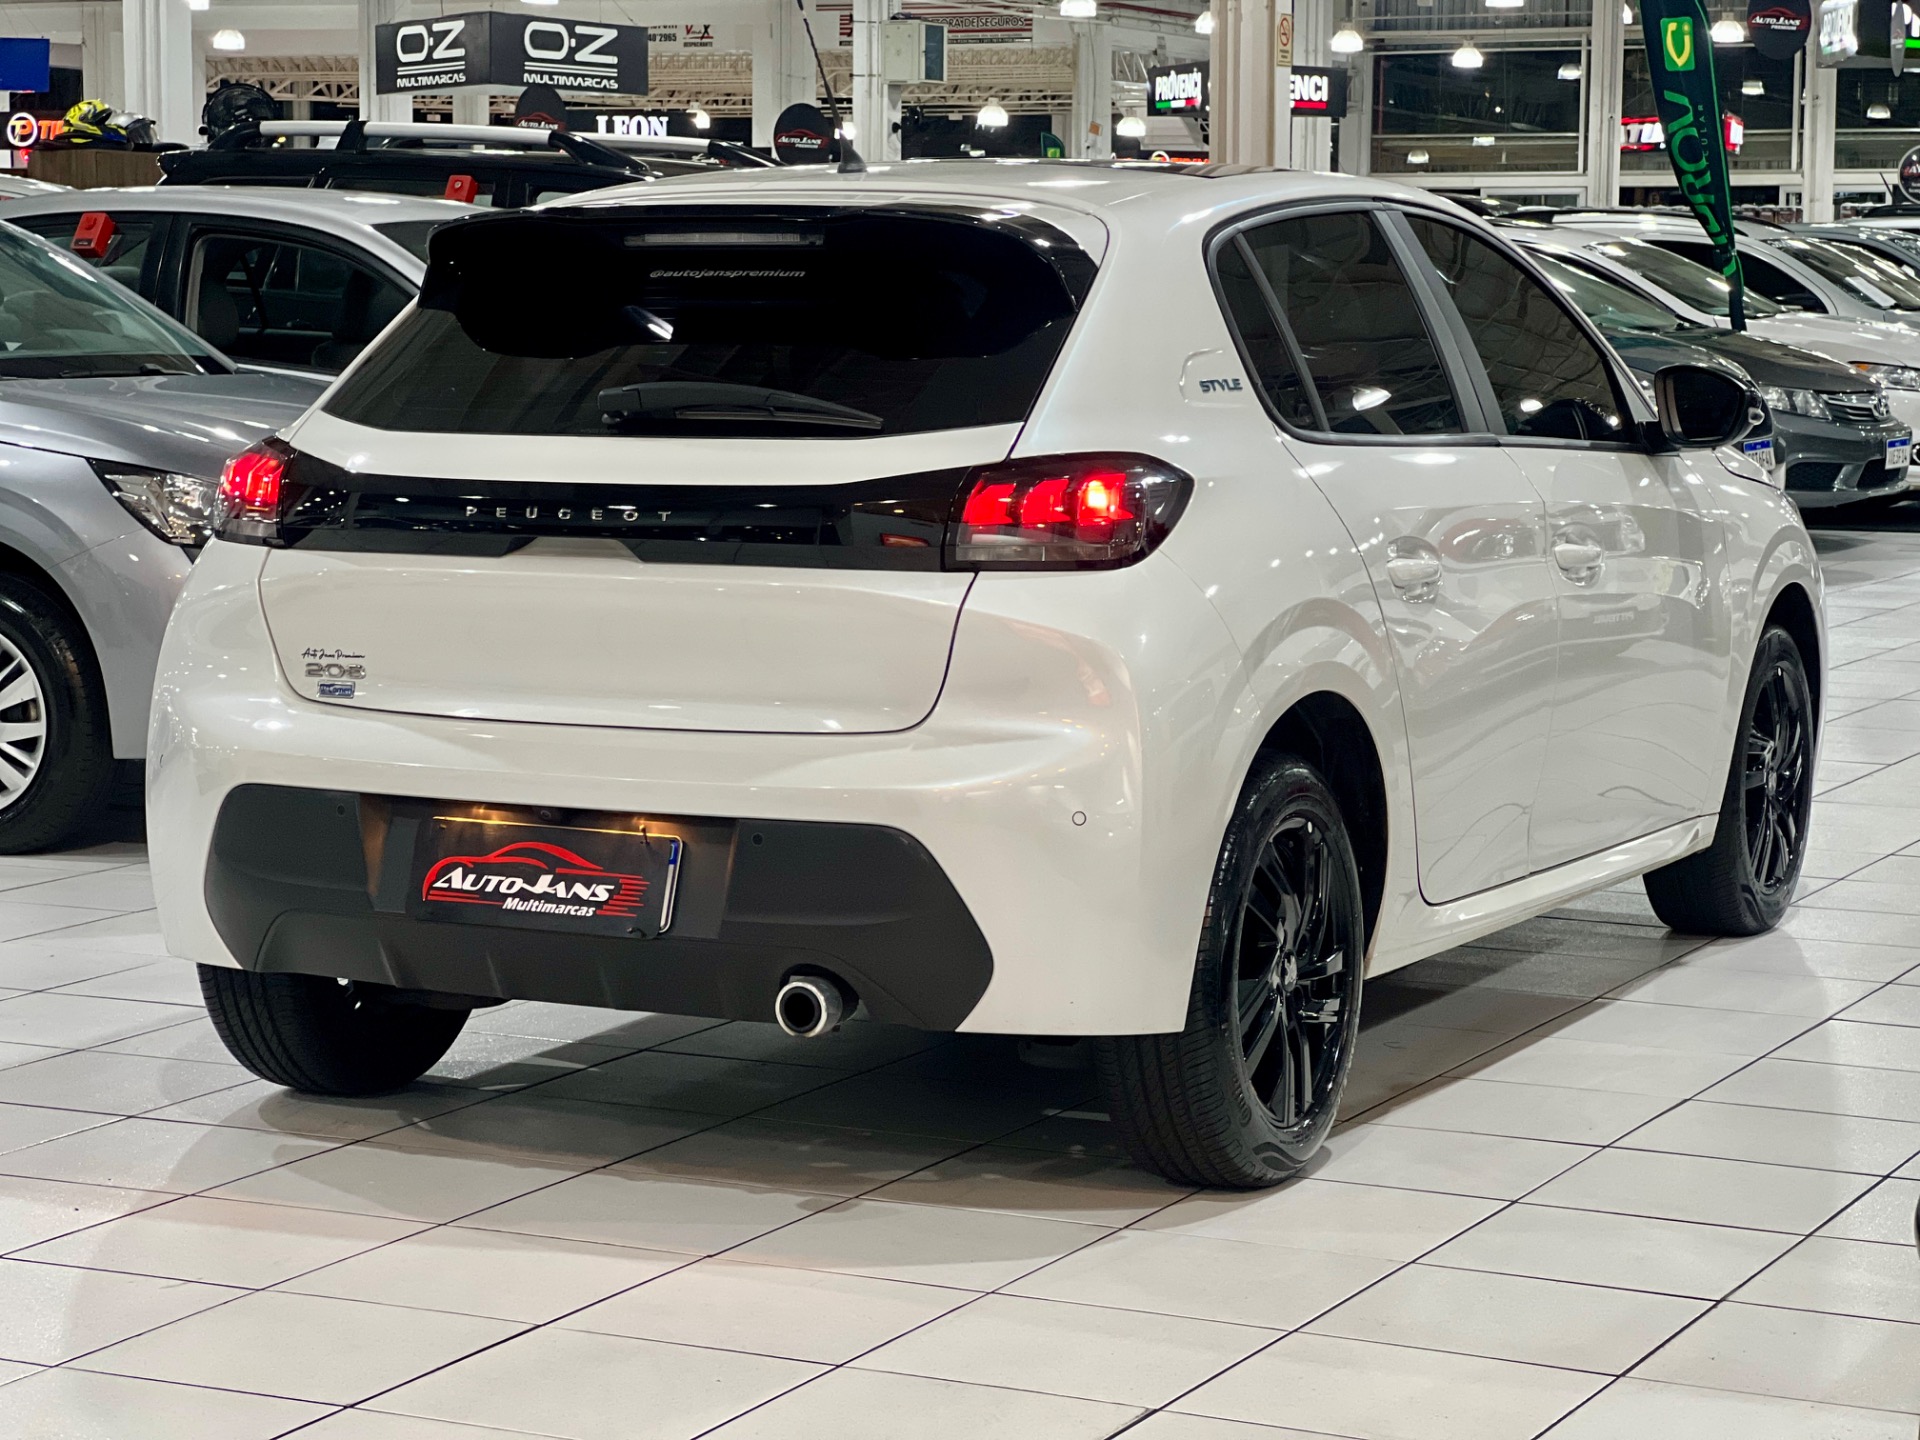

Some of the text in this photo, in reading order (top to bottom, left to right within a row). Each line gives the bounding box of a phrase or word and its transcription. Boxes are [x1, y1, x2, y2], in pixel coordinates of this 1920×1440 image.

[979, 16, 1025, 28] SEGUROS
[396, 73, 467, 88] MULTIMARCAS
[523, 73, 619, 89] MULTIMARCAS
[596, 114, 669, 138] LEON
[650, 268, 806, 279] @autojanspremium
[1199, 378, 1243, 393] STYLE
[465, 505, 672, 523] PEUGEOT
[305, 662, 367, 680] 208
[501, 896, 596, 918] Multimarcas
